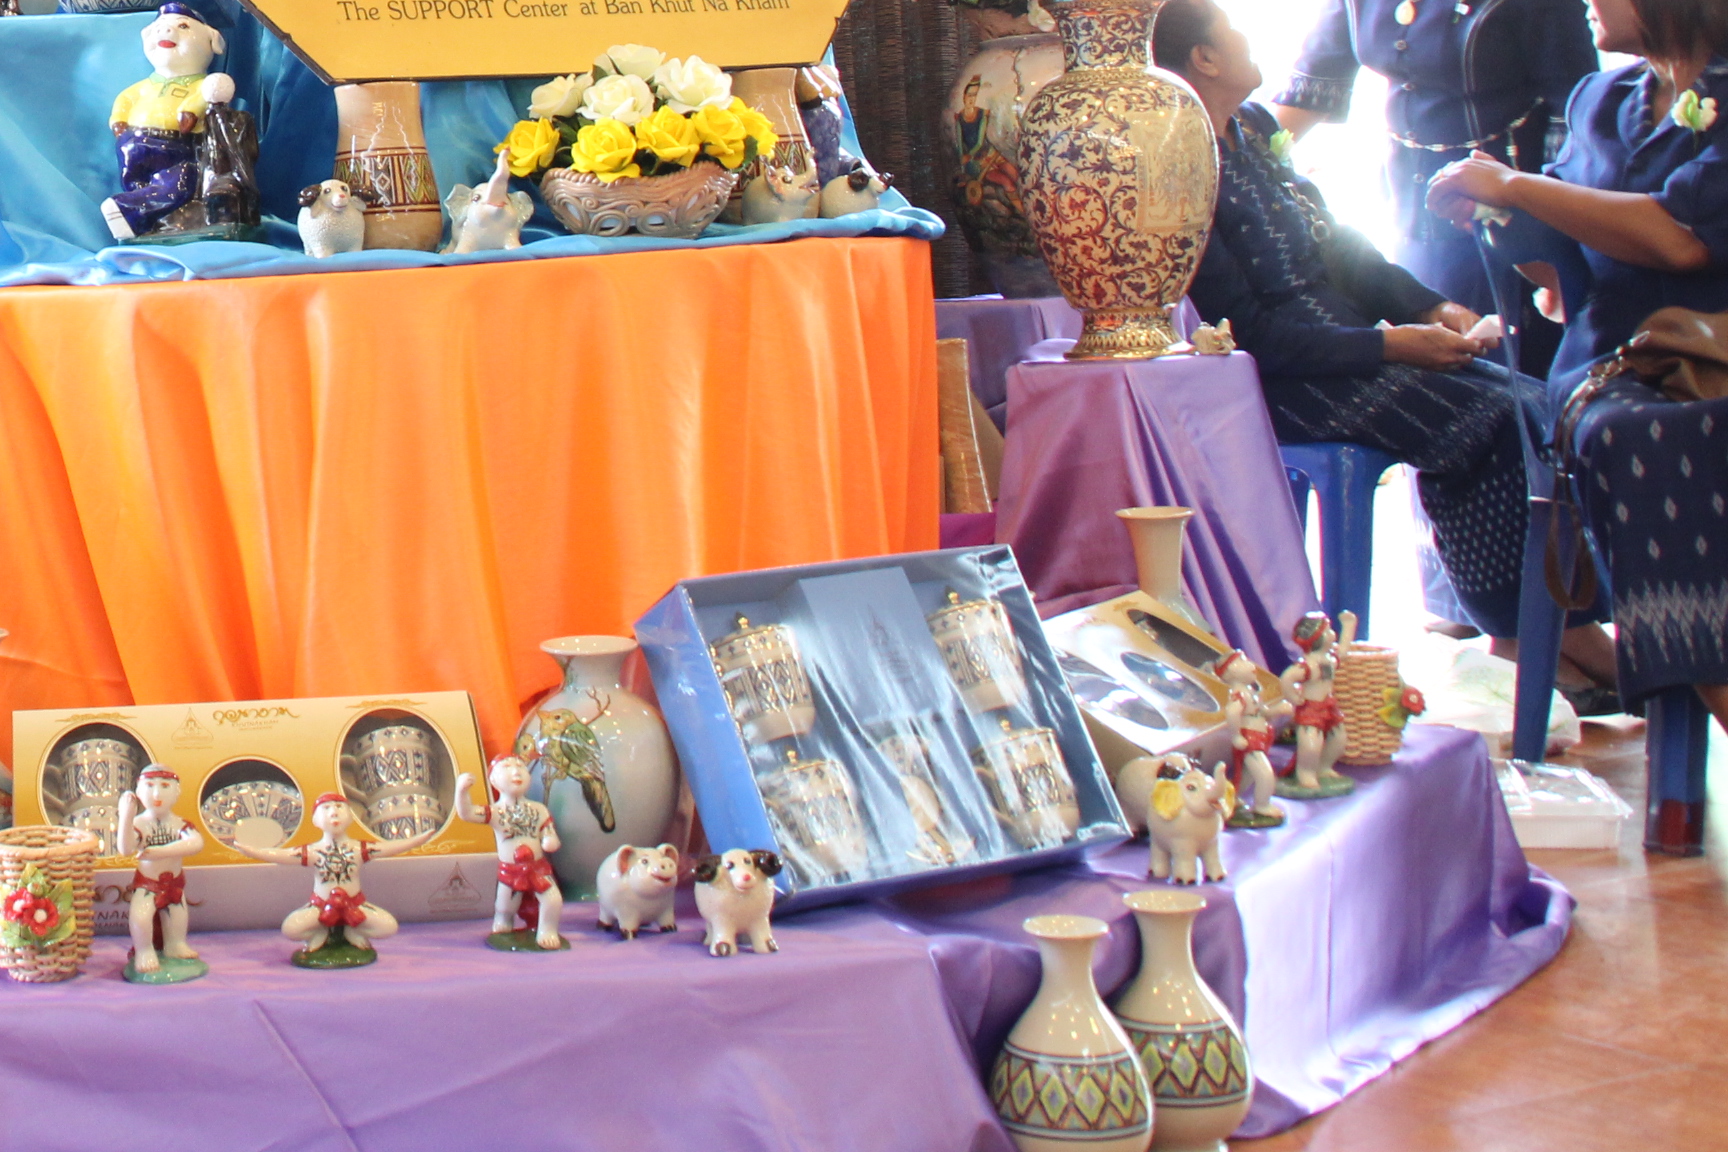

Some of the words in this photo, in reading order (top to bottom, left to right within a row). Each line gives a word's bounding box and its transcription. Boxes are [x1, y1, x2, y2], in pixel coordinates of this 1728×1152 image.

[337, 0, 380, 22] The
[386, 0, 494, 21] SUPPORT
[579, 0, 598, 16] at
